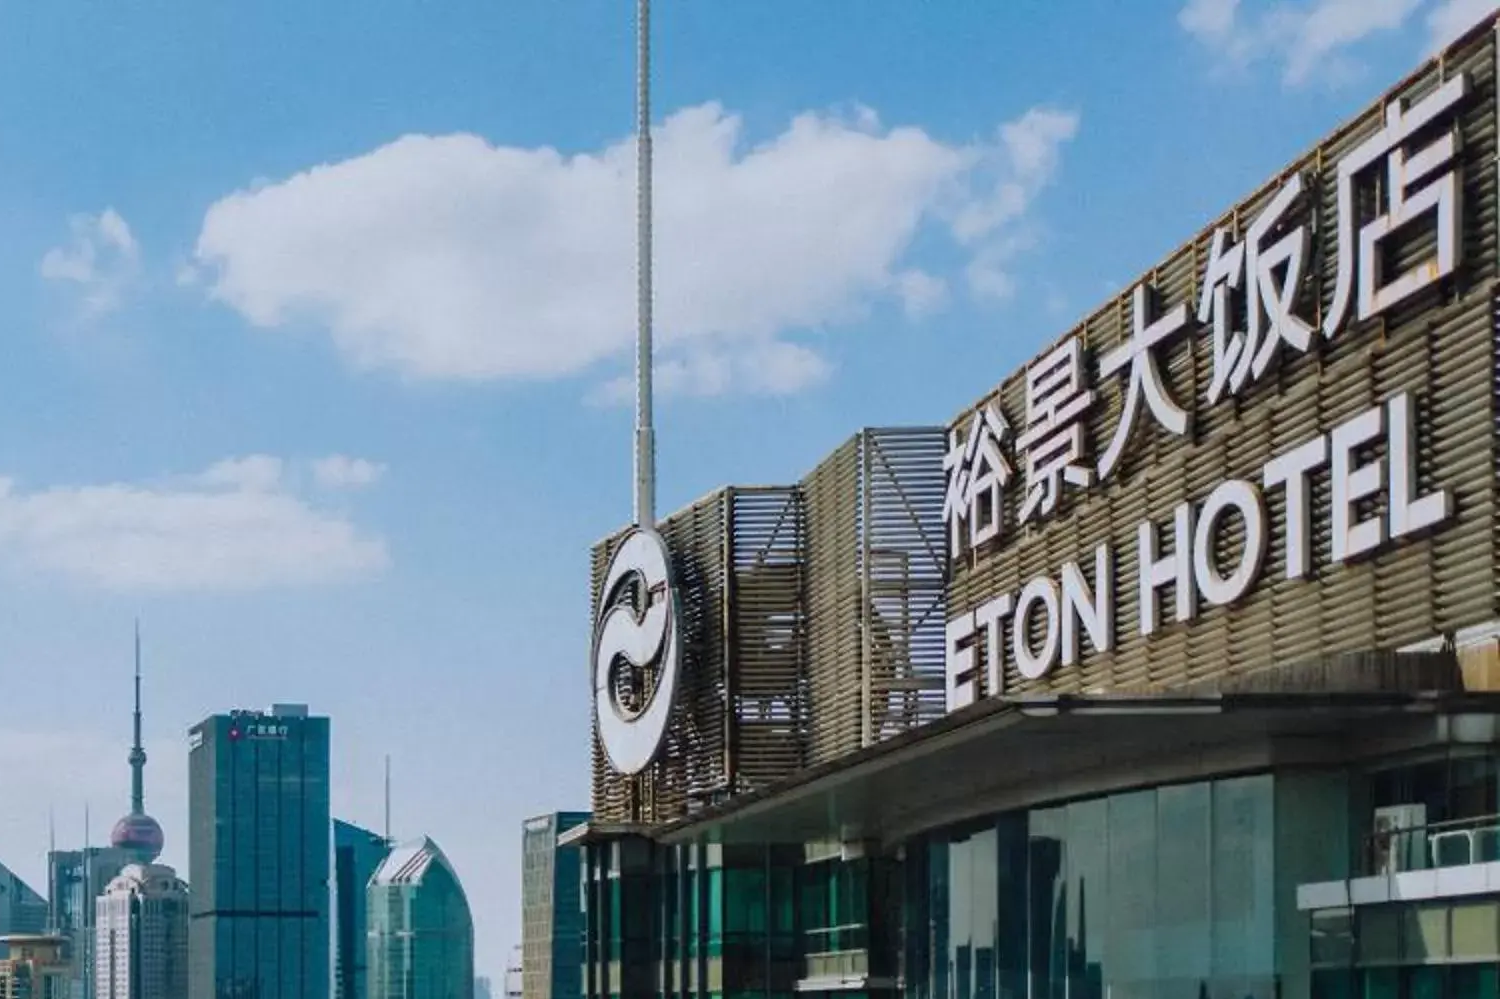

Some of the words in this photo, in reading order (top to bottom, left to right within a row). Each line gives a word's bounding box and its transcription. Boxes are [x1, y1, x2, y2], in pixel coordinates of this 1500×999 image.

[942, 73, 1474, 558] 裕景大饭店
[945, 542, 1114, 712] ETON
[1138, 391, 1455, 635] HOTEL
